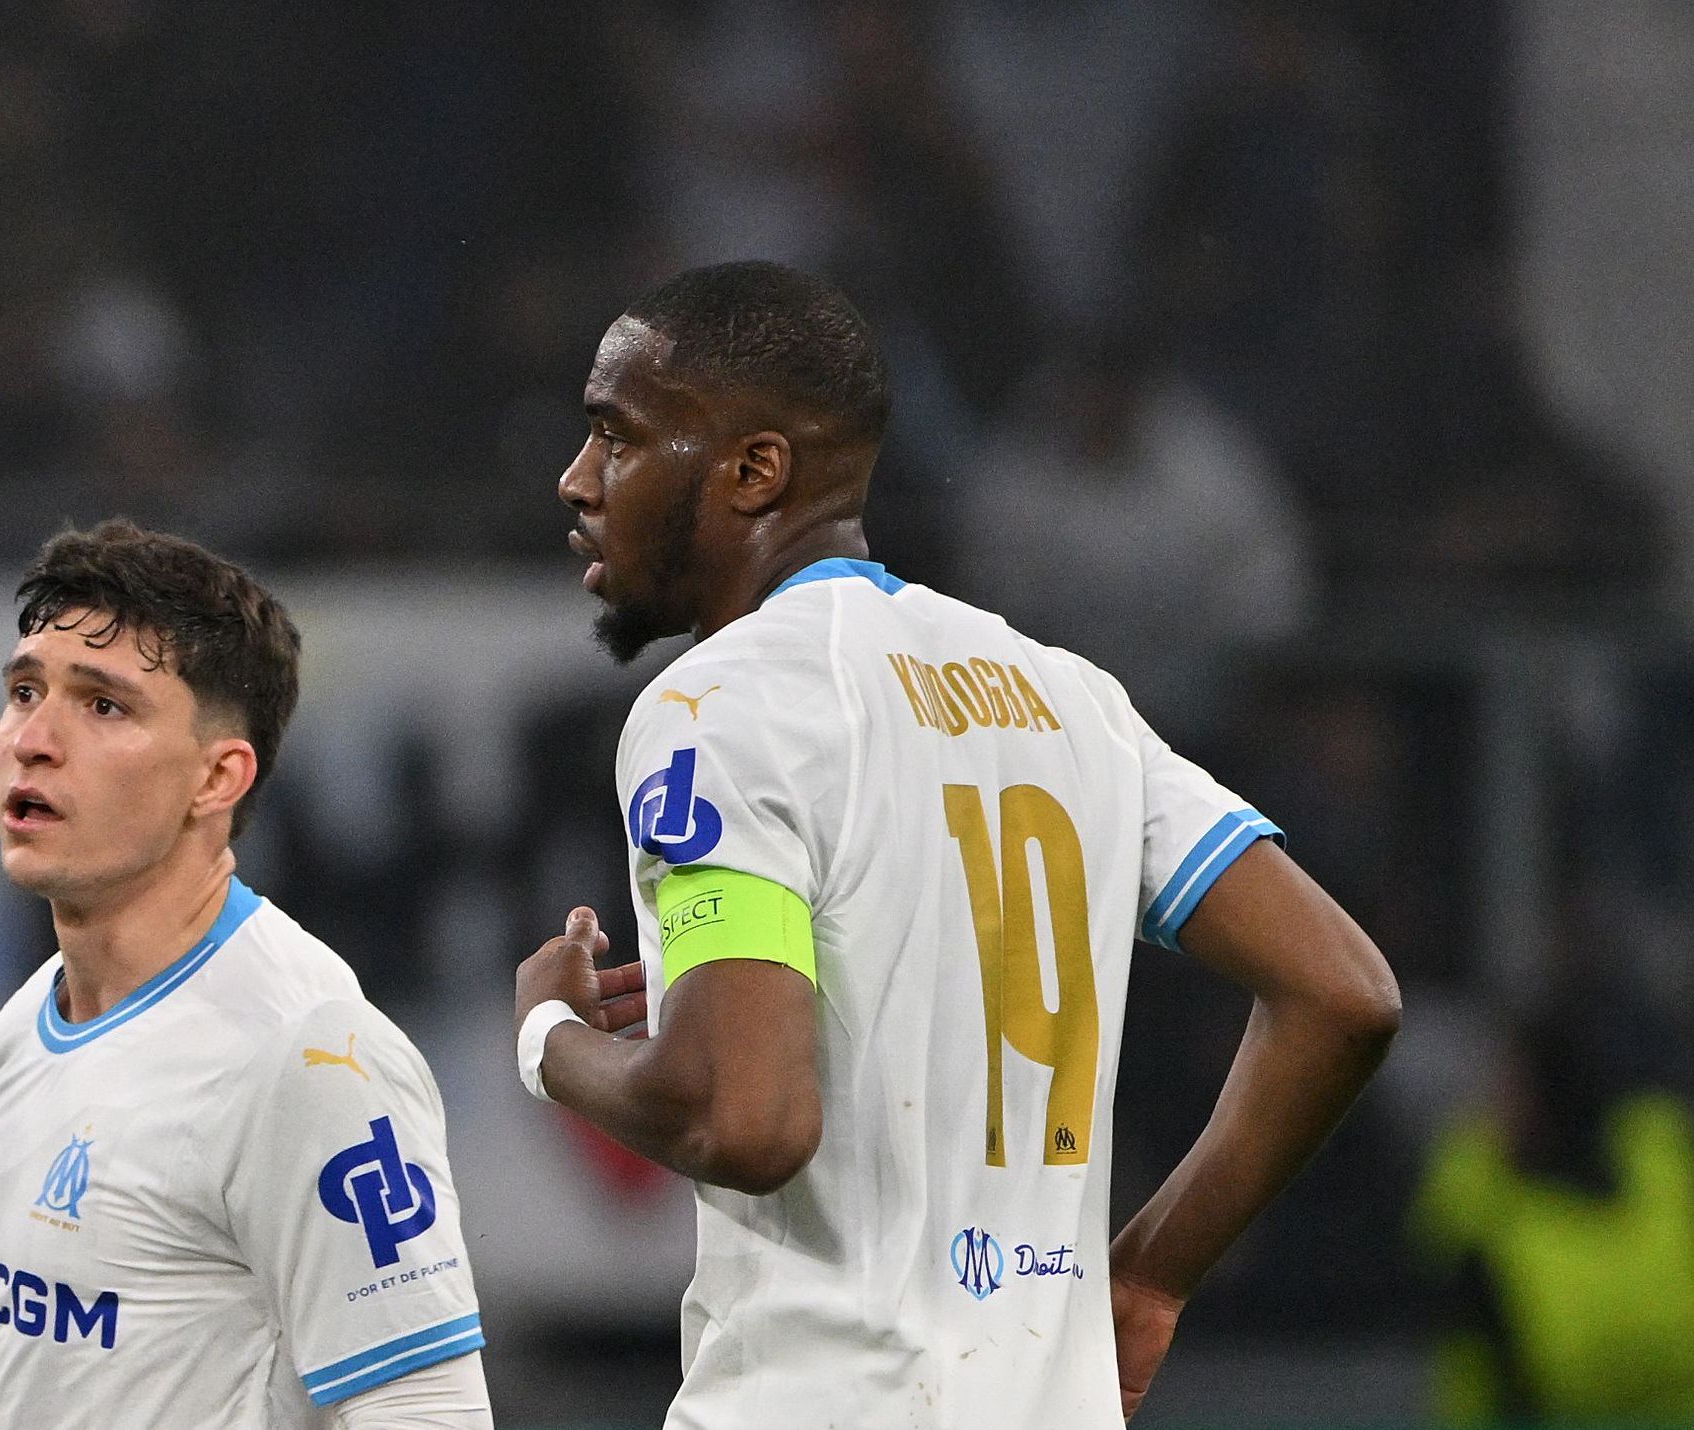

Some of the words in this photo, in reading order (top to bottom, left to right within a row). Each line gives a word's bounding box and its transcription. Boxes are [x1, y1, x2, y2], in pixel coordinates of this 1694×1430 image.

[662, 896, 724, 947] SPECT
[942, 783, 1100, 1168] 19
[347, 1283, 379, 1302] D'OR
[381, 1276, 396, 1290] ET
[400, 1270, 418, 1284] DE
[421, 1257, 459, 1278] PLATINE
